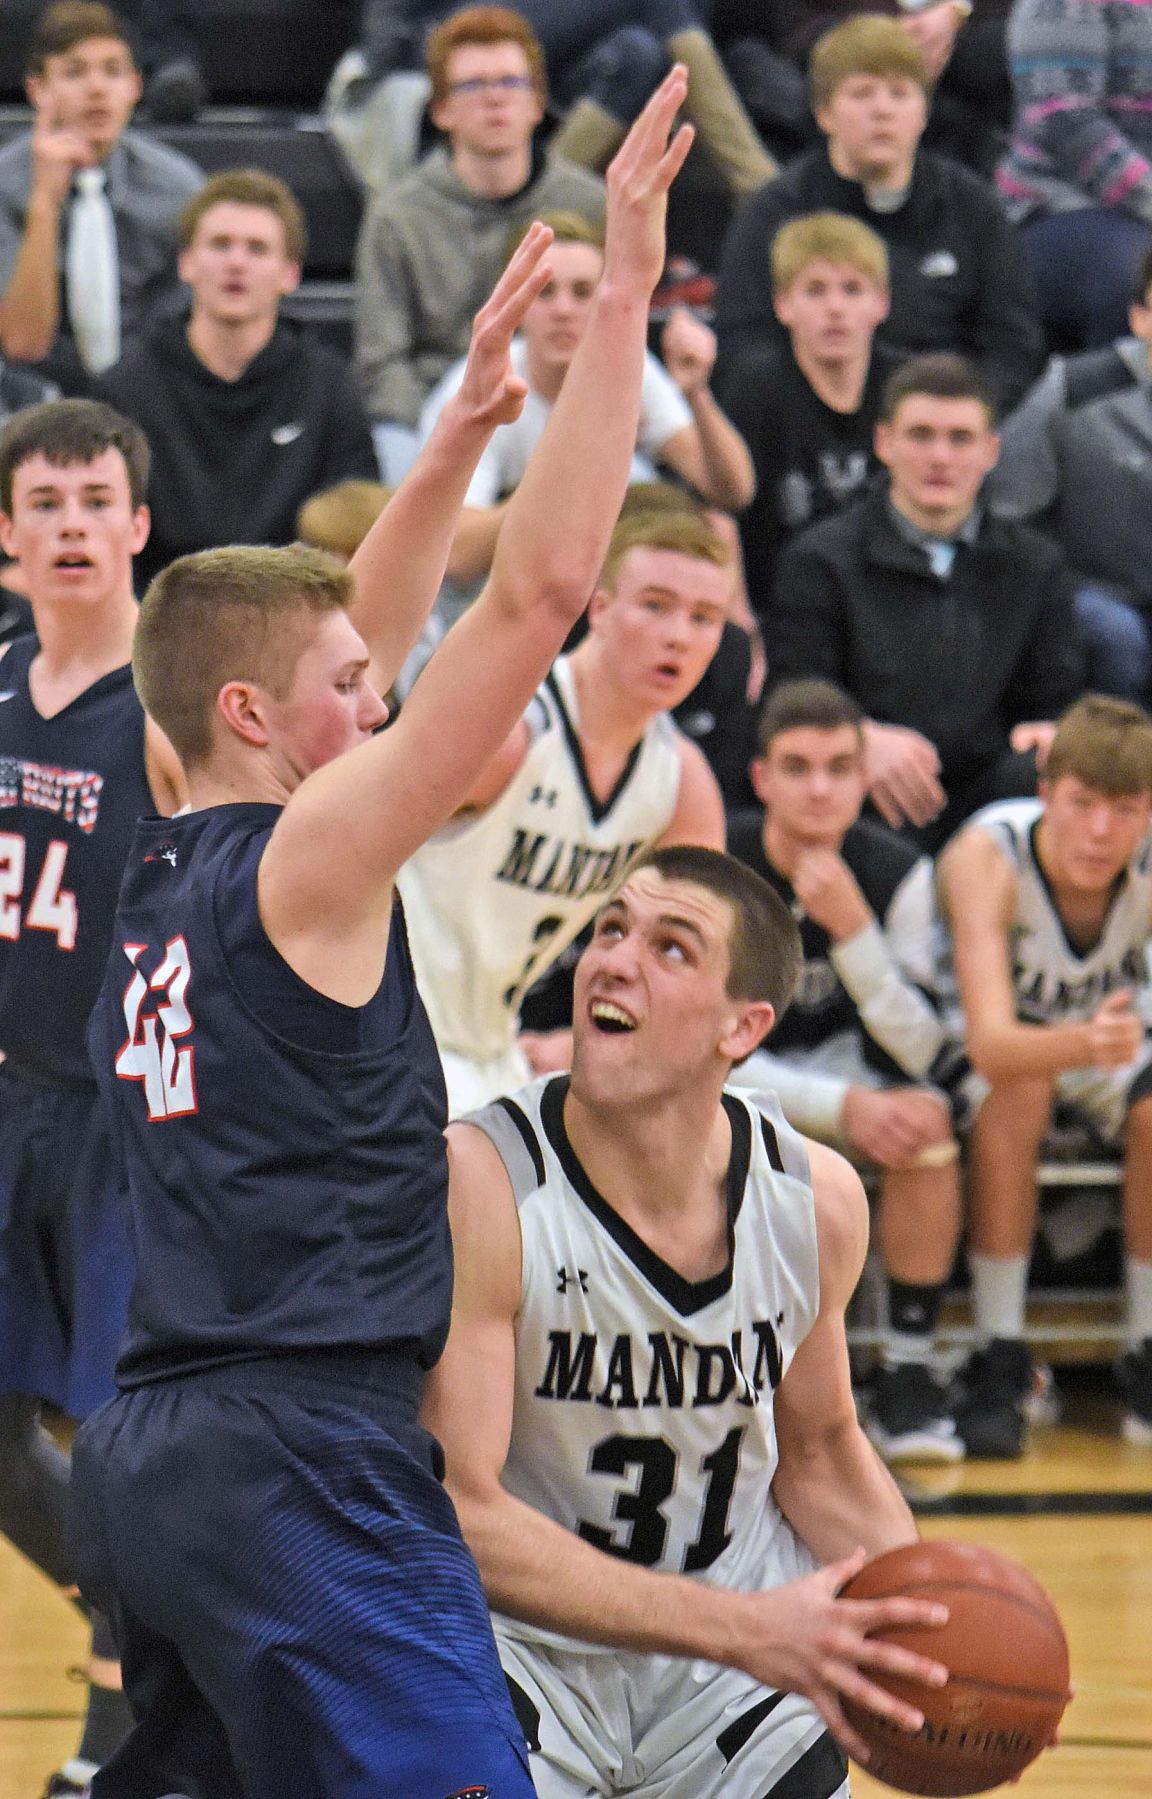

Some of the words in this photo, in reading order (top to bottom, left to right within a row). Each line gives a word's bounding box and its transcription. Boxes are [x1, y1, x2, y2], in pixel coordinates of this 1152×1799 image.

[0, 831, 78, 952] 24
[115, 934, 199, 1123] 42
[575, 1424, 748, 1574] 31
